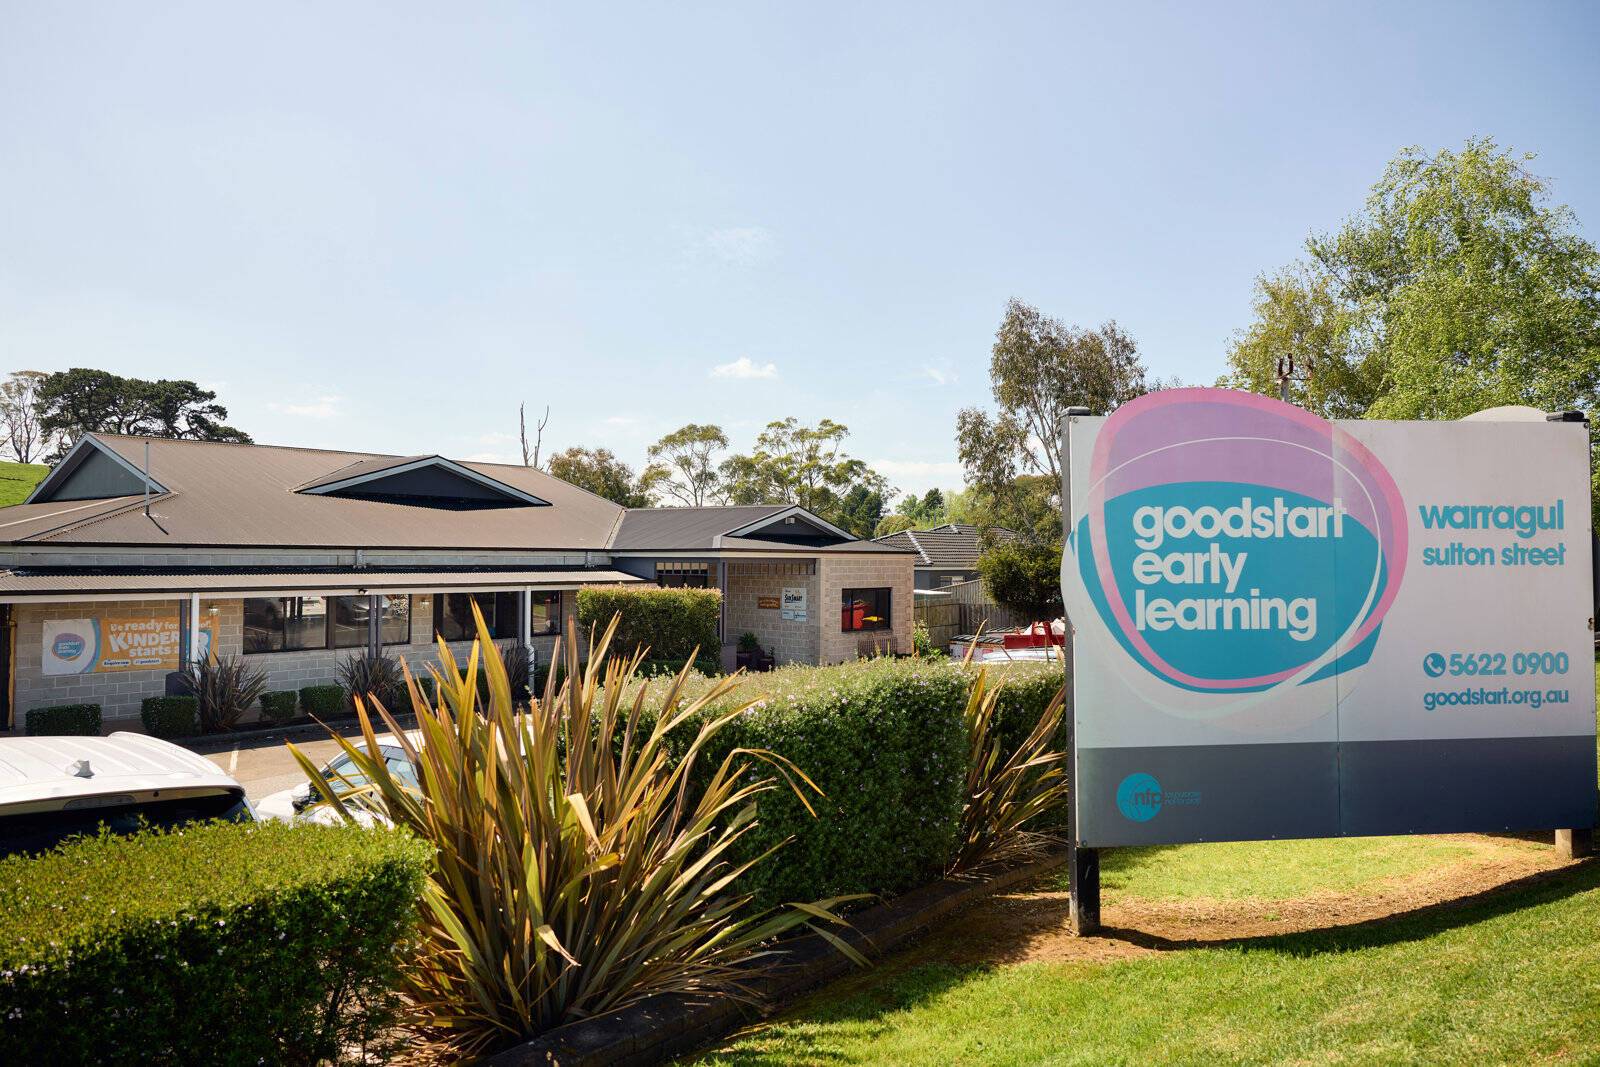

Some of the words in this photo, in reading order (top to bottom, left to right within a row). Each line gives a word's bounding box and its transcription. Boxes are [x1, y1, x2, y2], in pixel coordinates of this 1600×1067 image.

[1132, 497, 1348, 551] goodstart
[1418, 499, 1565, 539] warragul
[1422, 542, 1496, 566] sutton
[1501, 542, 1567, 566] street
[1132, 542, 1248, 593] early
[125, 620, 163, 632] ready
[165, 621, 178, 630] for
[1135, 588, 1318, 642] learning
[109, 631, 180, 653] KINDER
[129, 646, 172, 657] starts
[1449, 653, 1507, 676] 5622
[1512, 651, 1569, 675] 0900
[1423, 687, 1569, 711] goodstart.org.au
